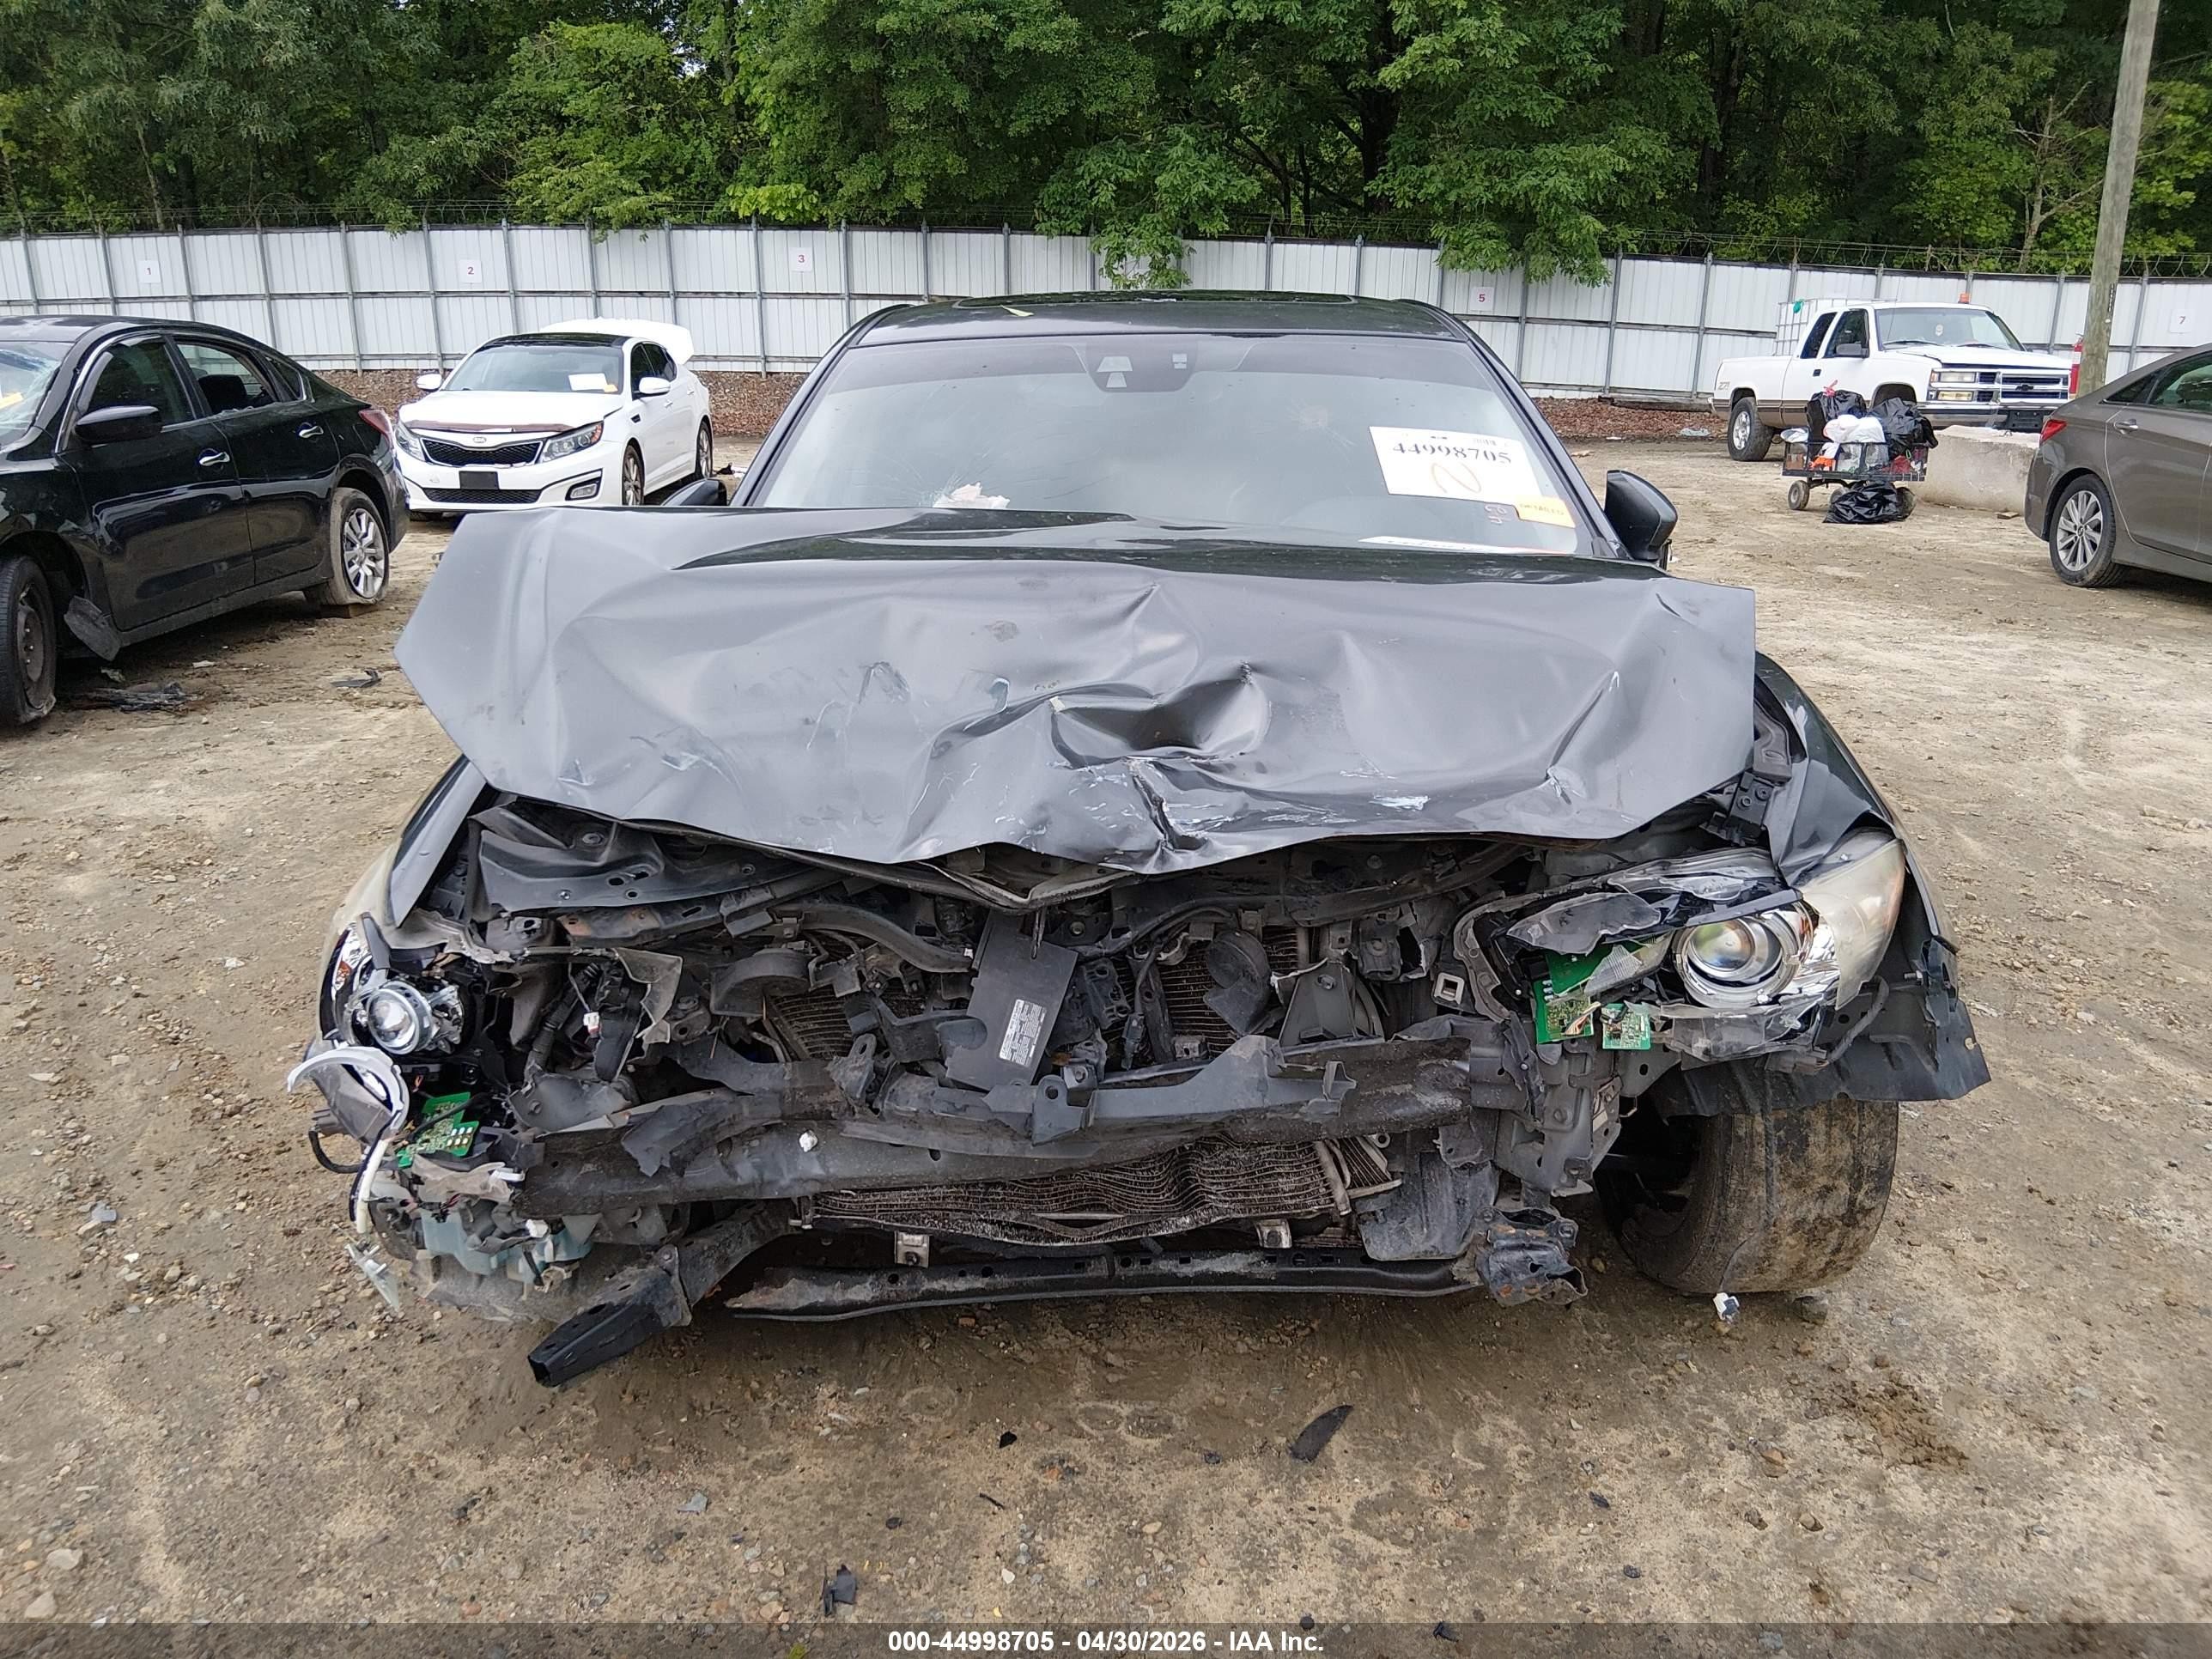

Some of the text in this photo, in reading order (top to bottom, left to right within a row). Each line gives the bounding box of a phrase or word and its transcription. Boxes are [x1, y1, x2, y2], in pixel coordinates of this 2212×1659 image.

[467, 266, 475, 275] 2
[1479, 294, 1486, 302] 5
[1393, 442, 1511, 464] 44998705
